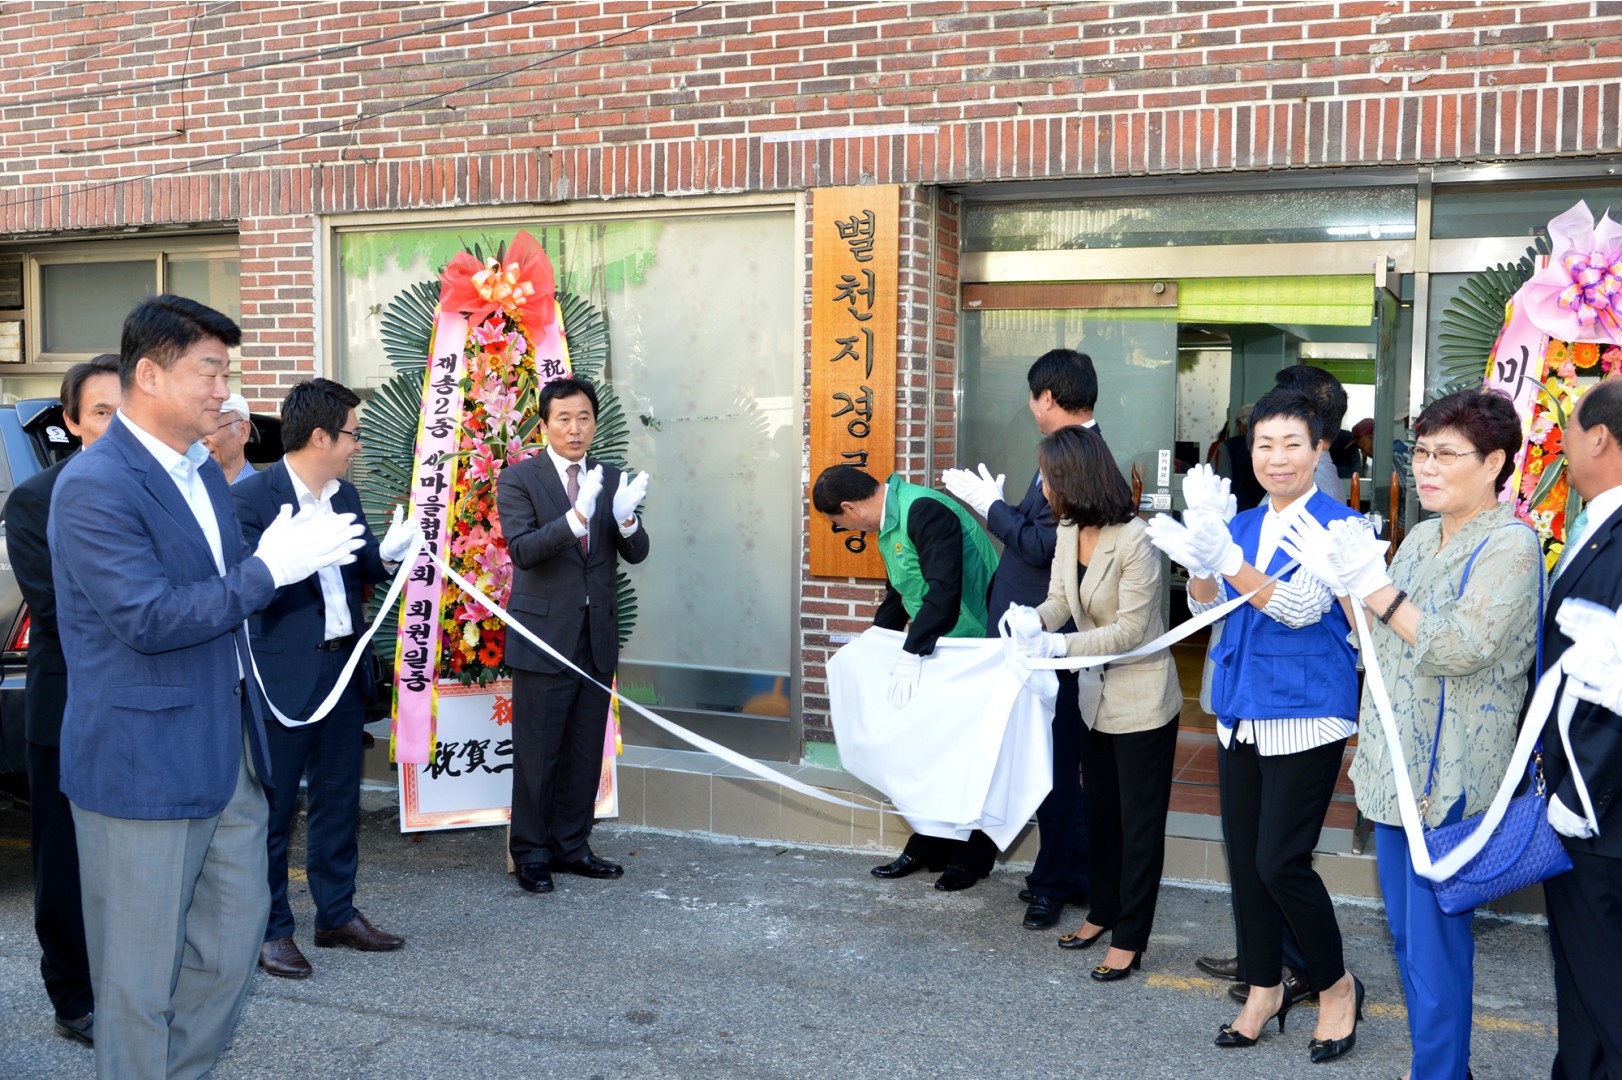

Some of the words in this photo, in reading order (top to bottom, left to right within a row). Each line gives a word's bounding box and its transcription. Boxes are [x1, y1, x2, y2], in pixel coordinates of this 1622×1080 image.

[425, 353, 459, 439] 재송2동
[540, 359, 566, 385] 祝
[1497, 345, 1529, 400] 미
[400, 599, 432, 692] 회원일동
